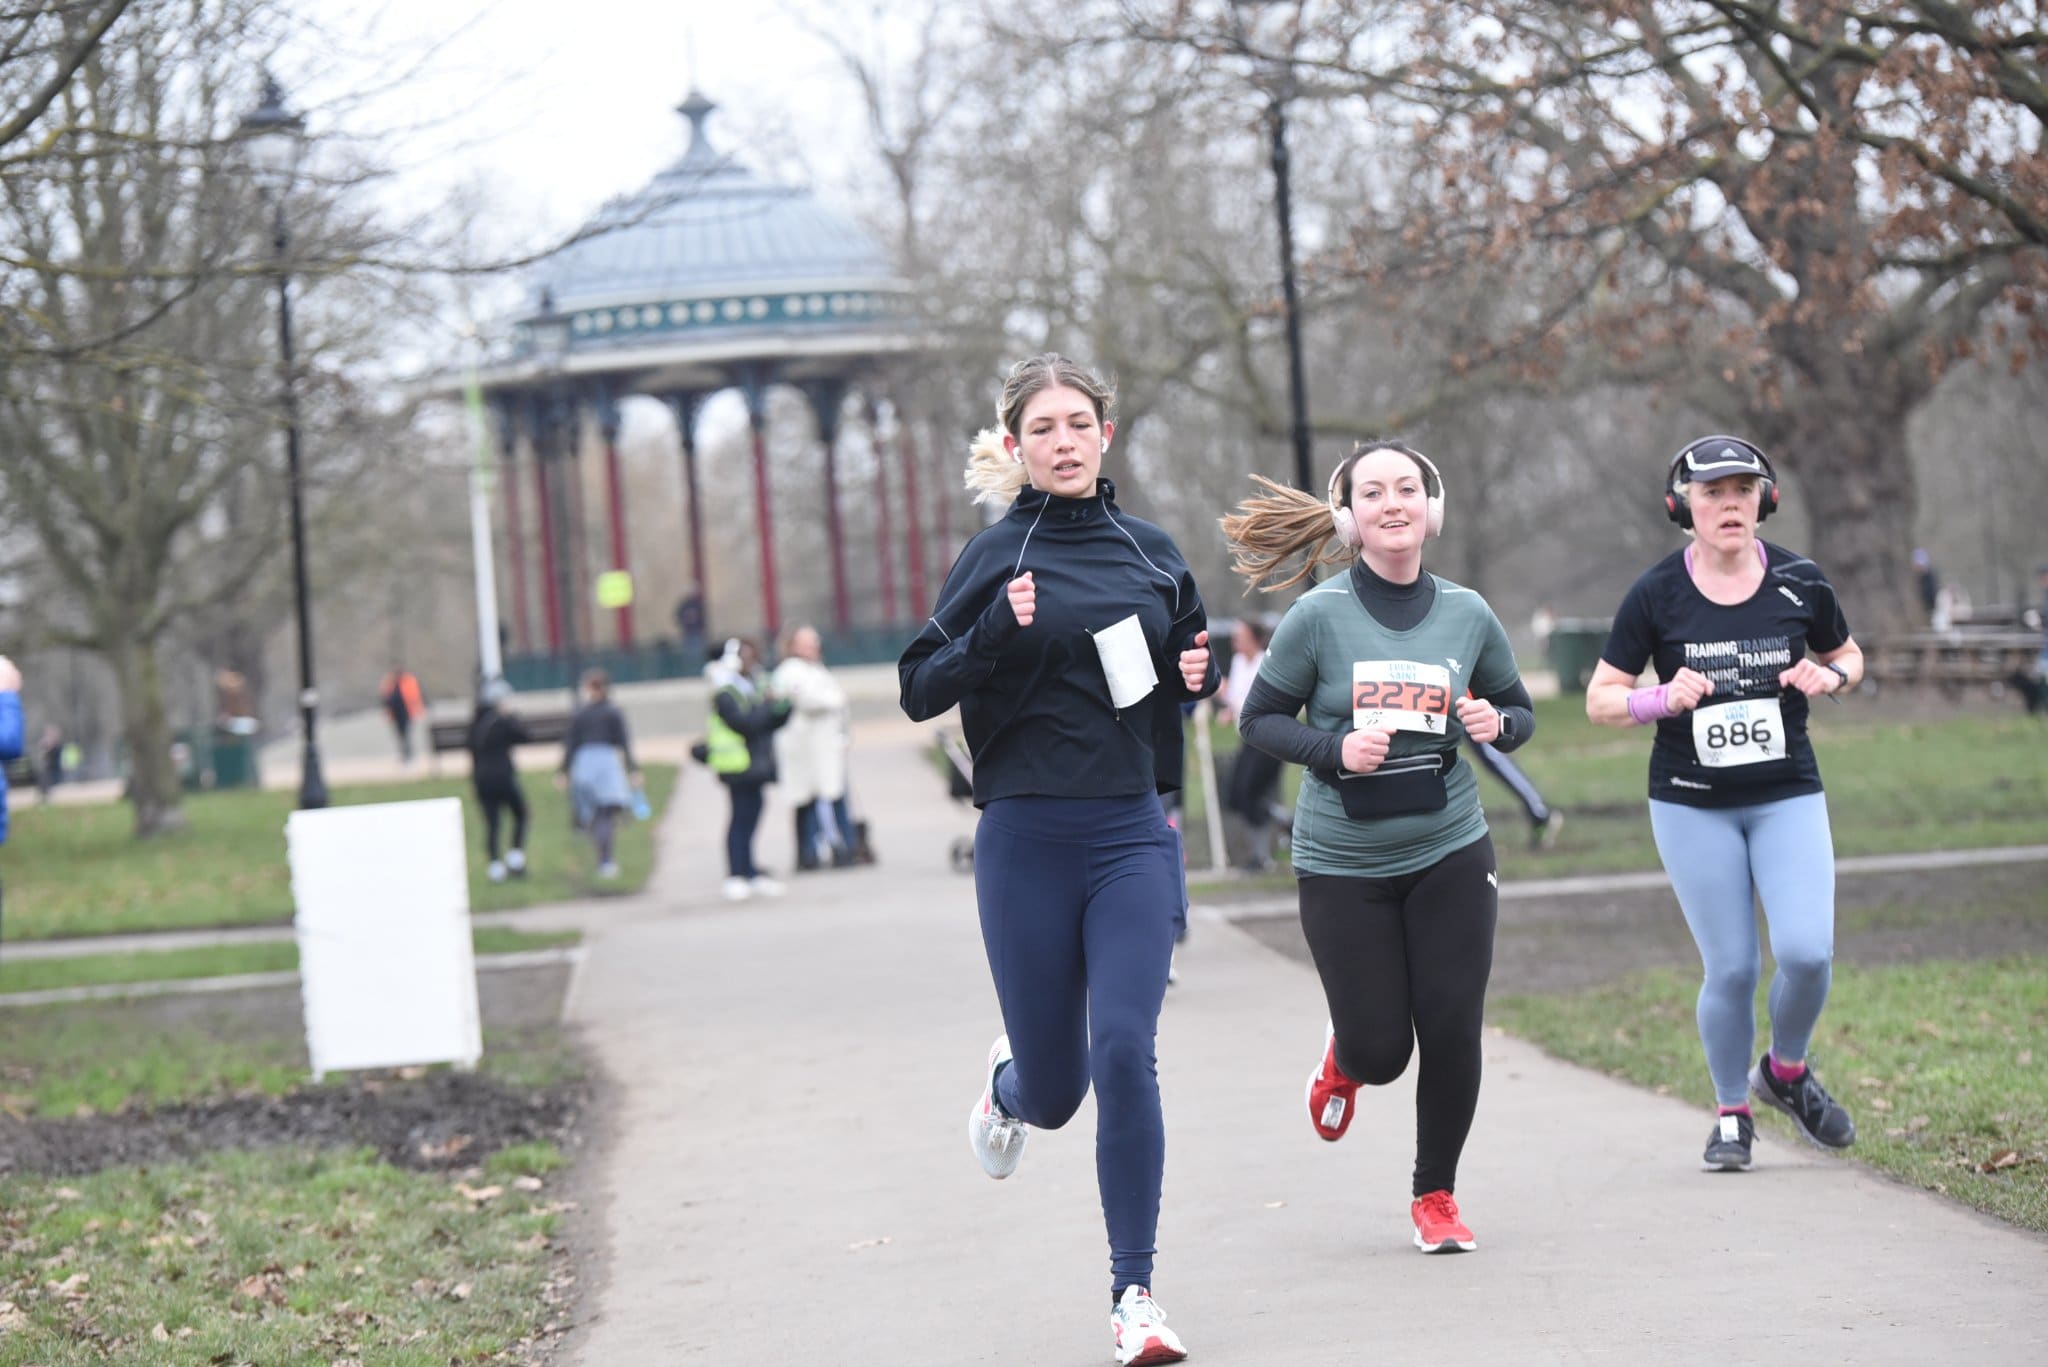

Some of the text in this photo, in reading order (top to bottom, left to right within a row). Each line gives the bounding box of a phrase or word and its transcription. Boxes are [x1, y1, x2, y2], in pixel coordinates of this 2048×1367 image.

[1684, 636, 1790, 659] TRAINING TRAINING
[1738, 649, 1791, 668] TRAINING
[1699, 667, 1739, 681] AINING
[1357, 681, 1446, 713] 2273
[1707, 719, 1771, 748] 886
